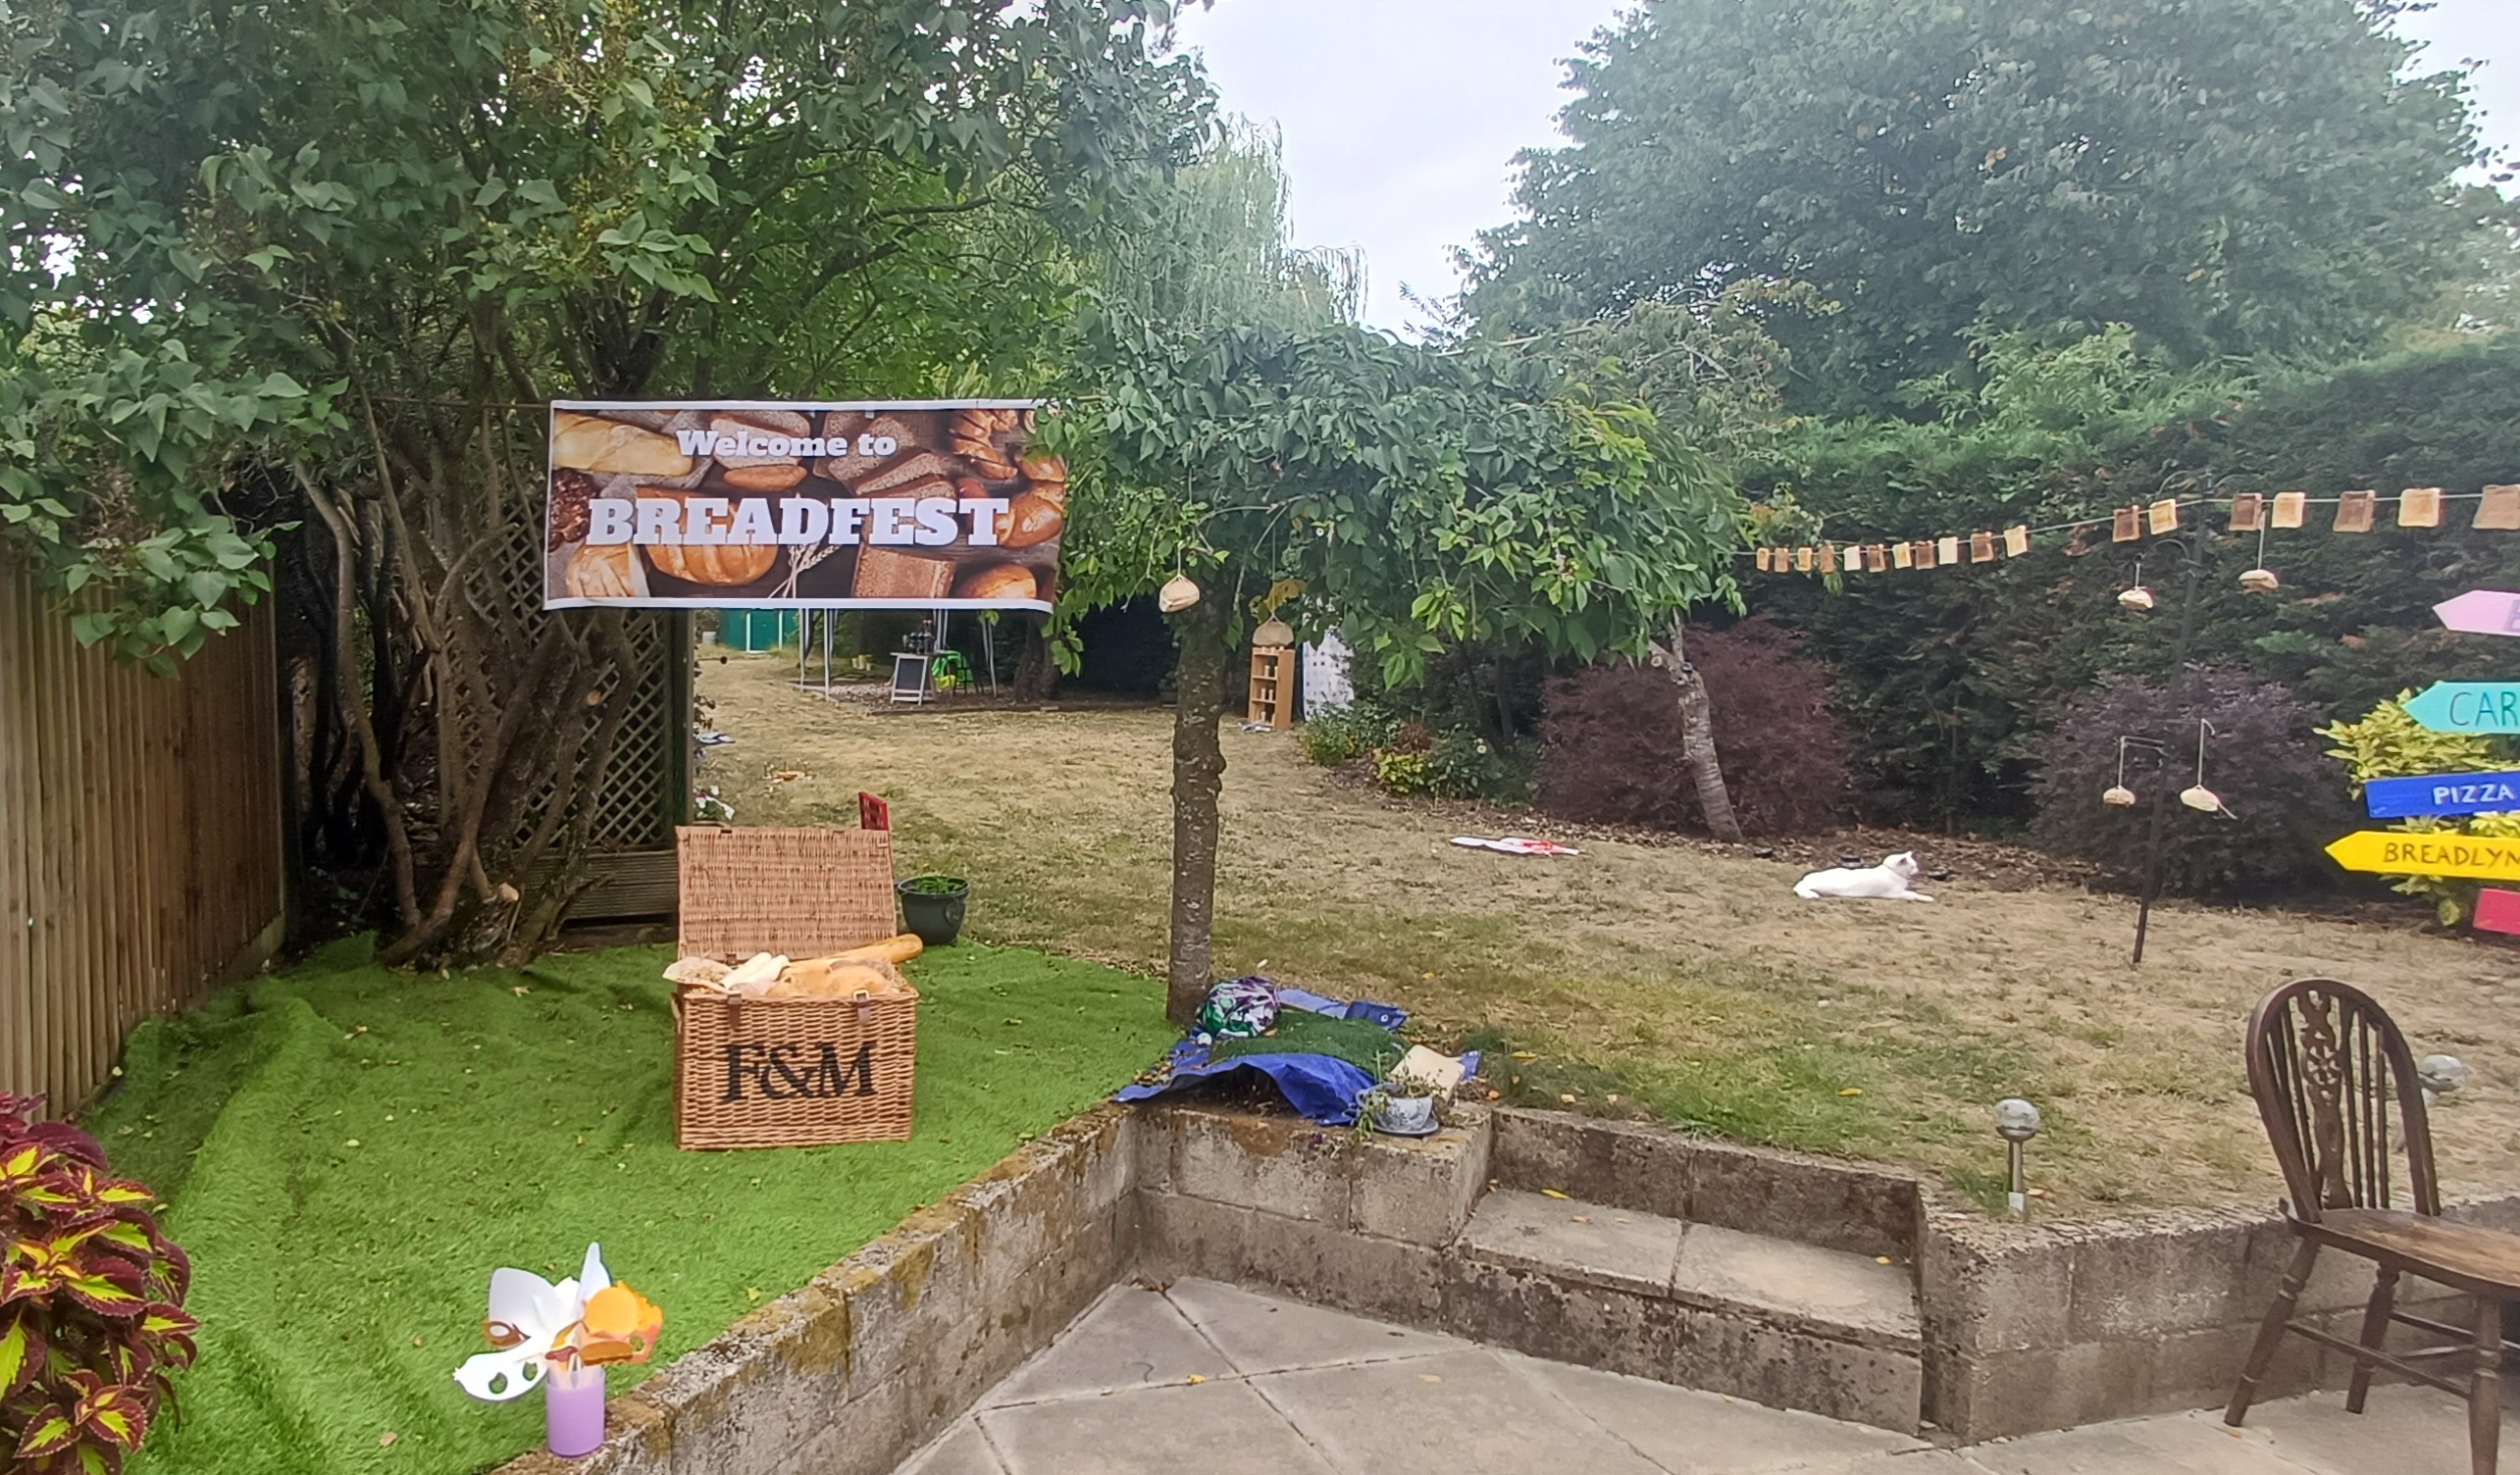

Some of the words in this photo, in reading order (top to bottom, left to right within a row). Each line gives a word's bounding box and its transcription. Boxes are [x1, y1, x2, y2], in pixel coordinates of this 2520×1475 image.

[676, 430, 848, 457] Welcome
[857, 433, 897, 456] to
[586, 497, 1009, 546] BREADFEST
[2449, 691, 2519, 727] CAR
[2433, 783, 2516, 805] PIZZA
[721, 1041, 879, 1102] F&M
